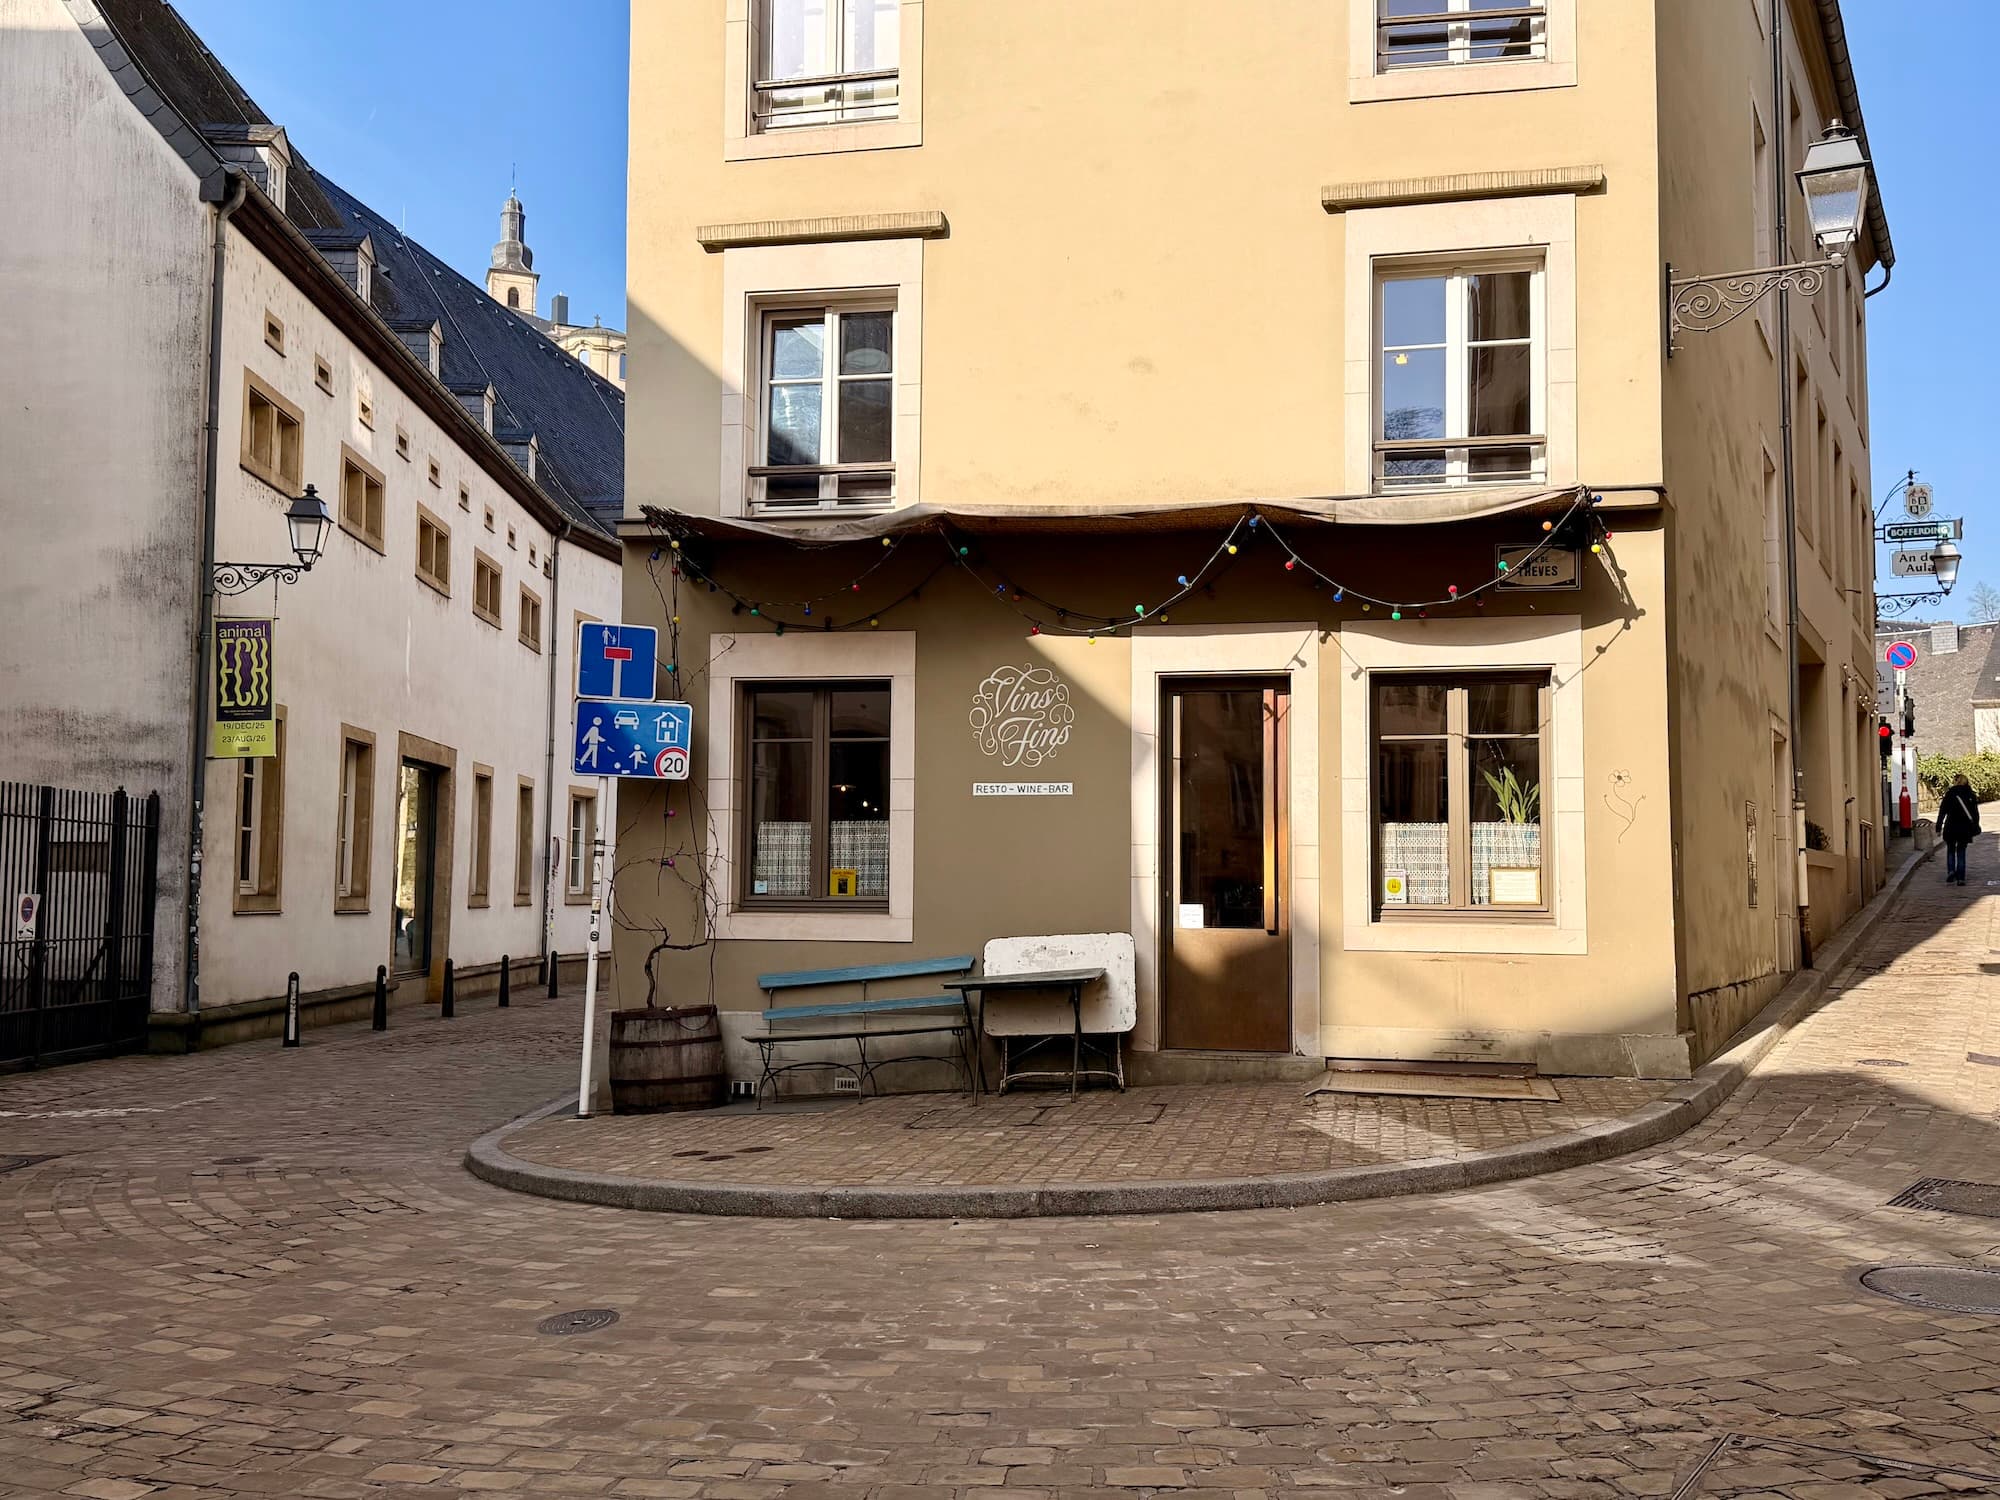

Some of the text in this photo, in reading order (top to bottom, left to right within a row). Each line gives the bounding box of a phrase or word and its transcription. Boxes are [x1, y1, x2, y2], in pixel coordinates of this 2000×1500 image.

[1890, 525, 1949, 537] BOFFERDING
[1899, 553, 1916, 563] An
[218, 625, 266, 639] animal
[220, 637, 269, 707] ECH
[979, 664, 1056, 718] Vins
[223, 722, 265, 730] 19/DEC/25
[222, 734, 266, 743] 23/AUG/26
[997, 710, 1073, 767] Fins
[663, 757, 684, 773] 20
[975, 785, 1007, 794] RESTO
